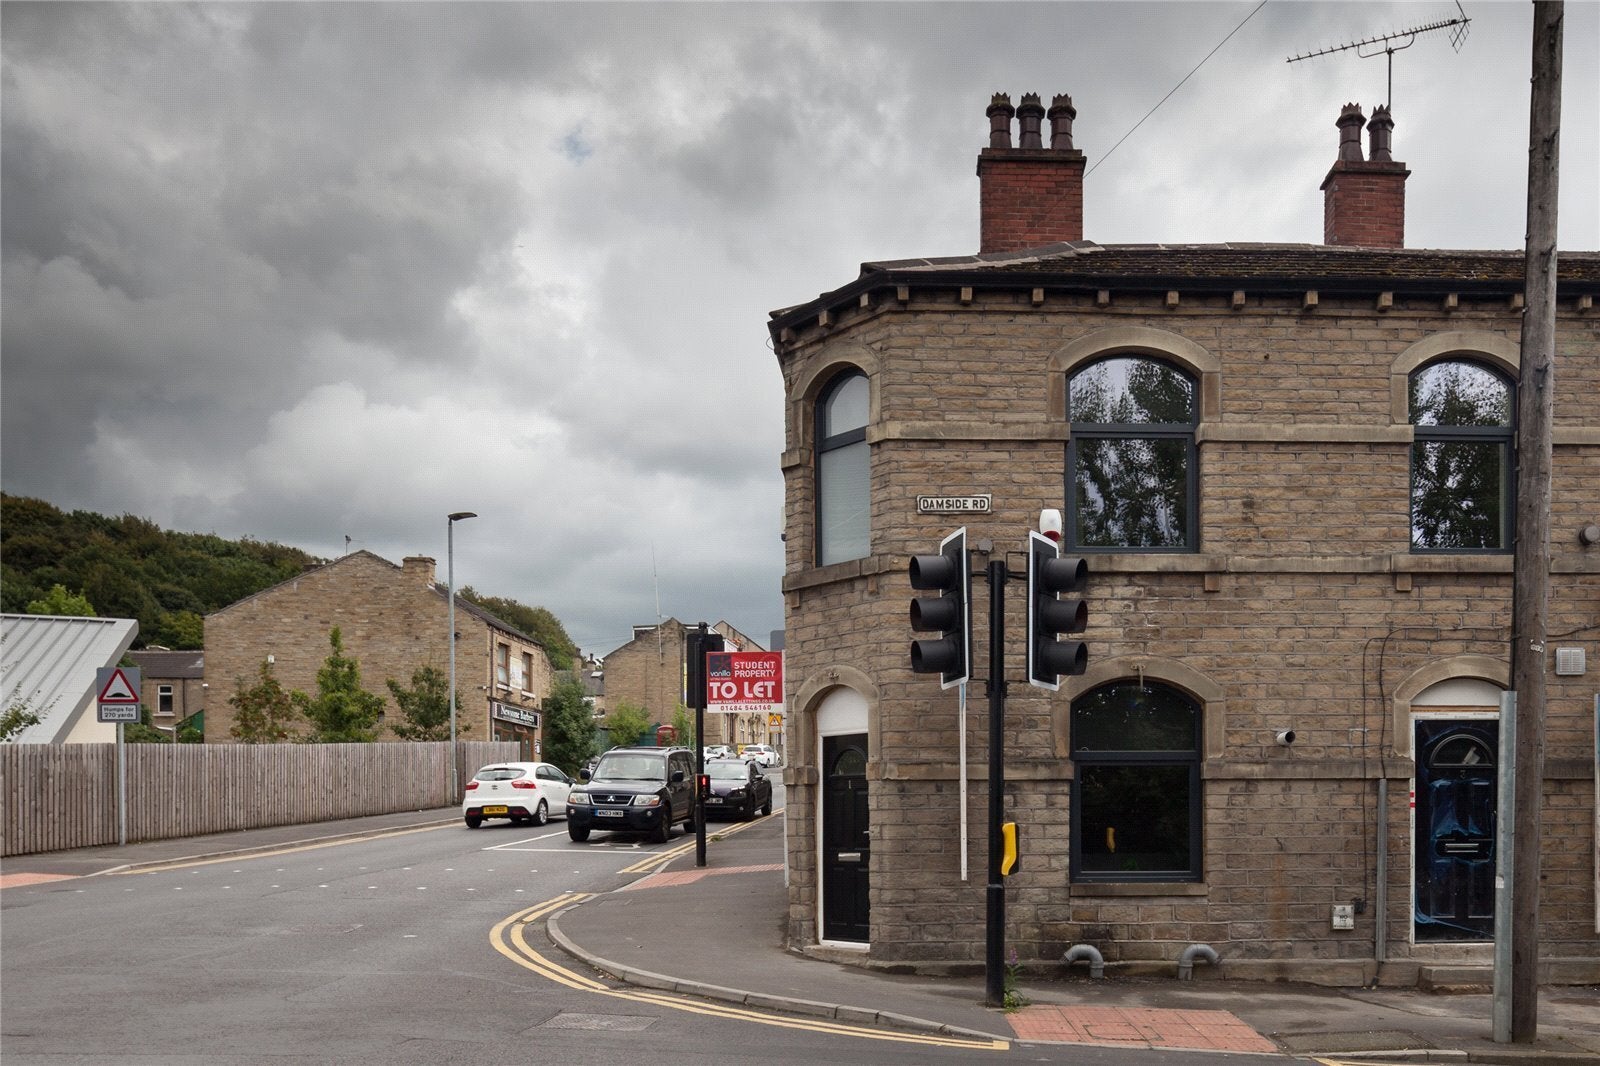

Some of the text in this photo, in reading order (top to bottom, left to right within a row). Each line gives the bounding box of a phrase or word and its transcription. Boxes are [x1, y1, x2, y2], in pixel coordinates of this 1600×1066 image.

[922, 499, 986, 509] DAMSIDE RD
[734, 661, 775, 669] STUDENT
[734, 669, 775, 678] PROPERTY
[709, 681, 775, 699] TO LET
